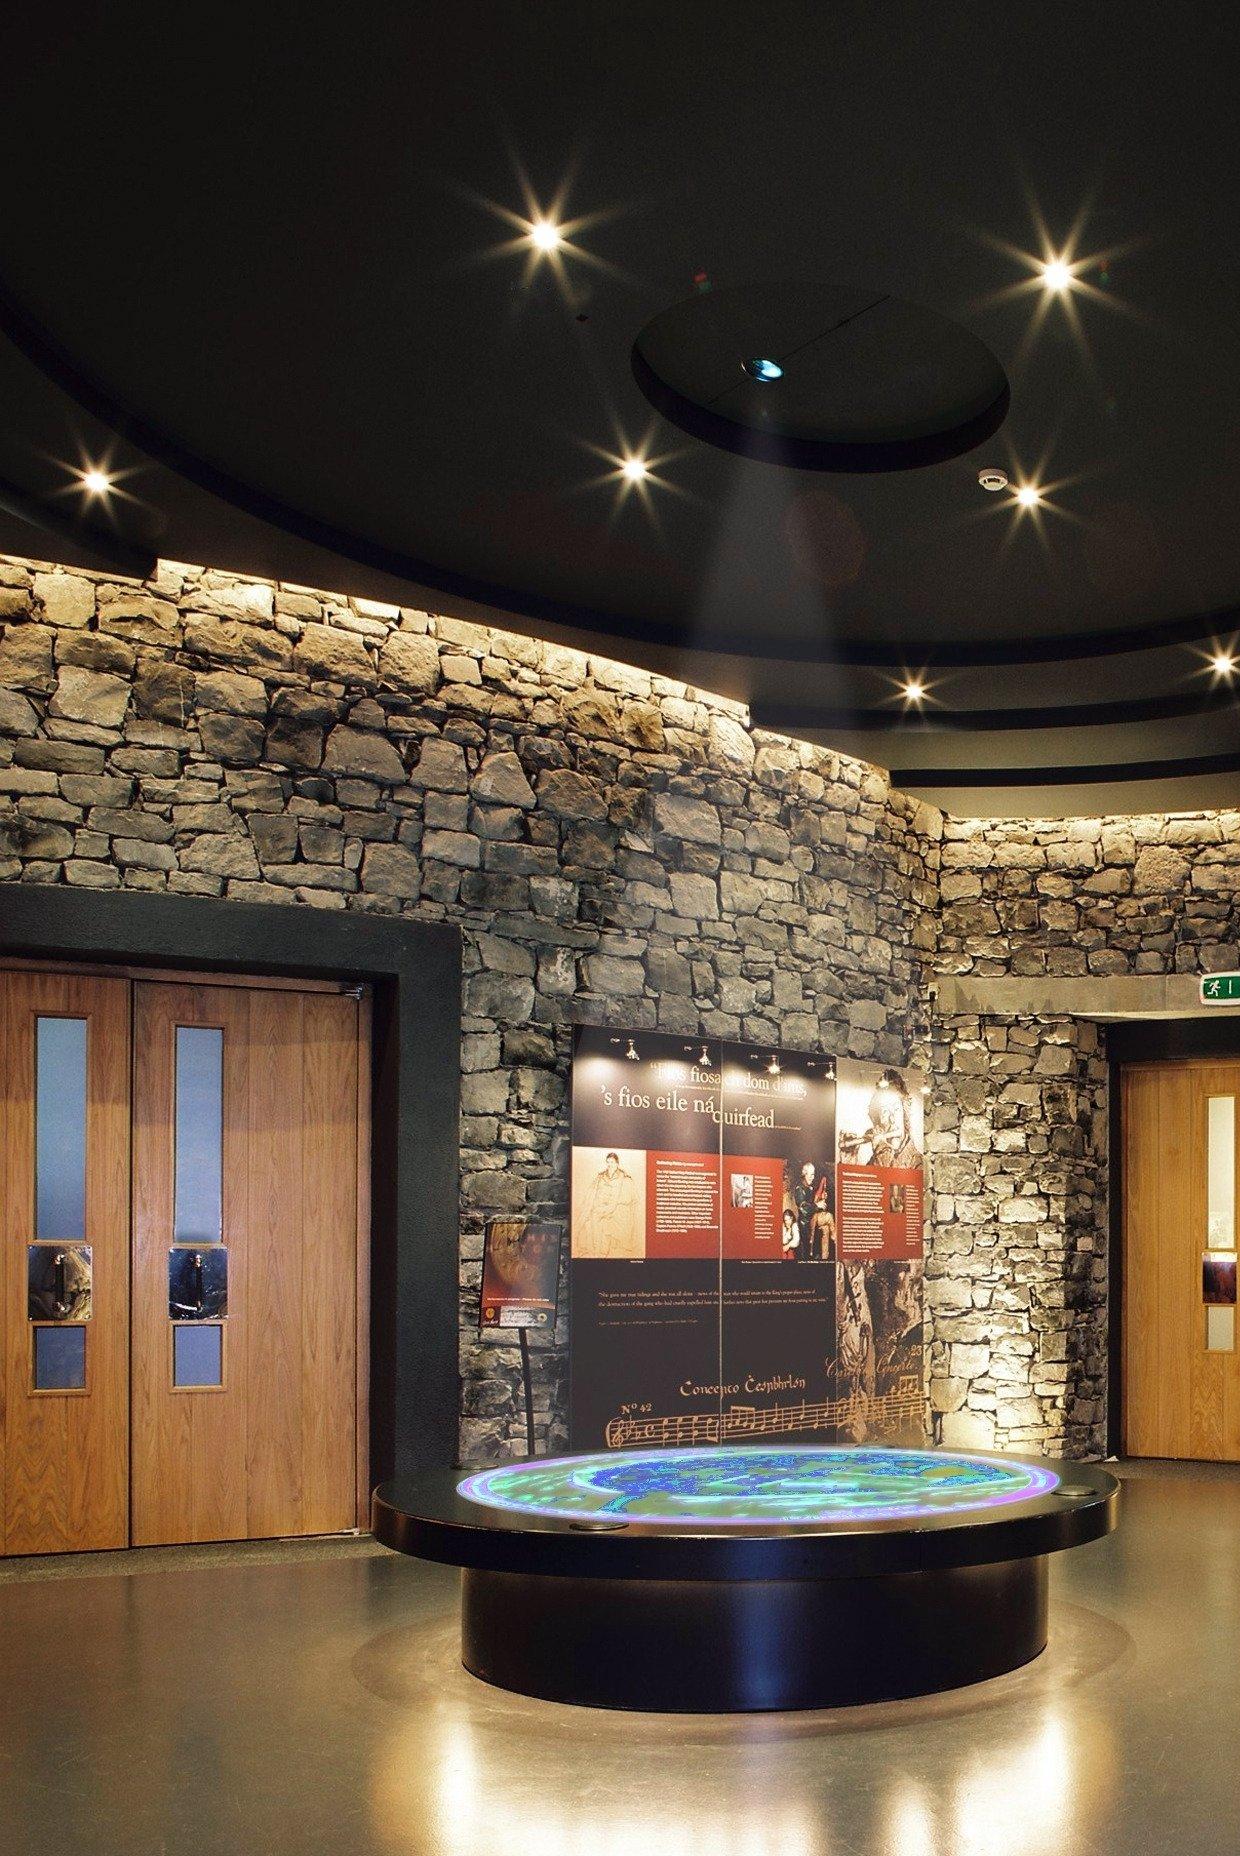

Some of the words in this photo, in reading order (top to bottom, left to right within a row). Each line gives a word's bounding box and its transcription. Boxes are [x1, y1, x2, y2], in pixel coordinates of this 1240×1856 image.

[744, 1072, 770, 1090] dom
[618, 1088, 650, 1109] fios
[656, 1090, 688, 1112] eile
[693, 1096, 715, 1114] ná
[712, 1107, 775, 1129] cuirfead
